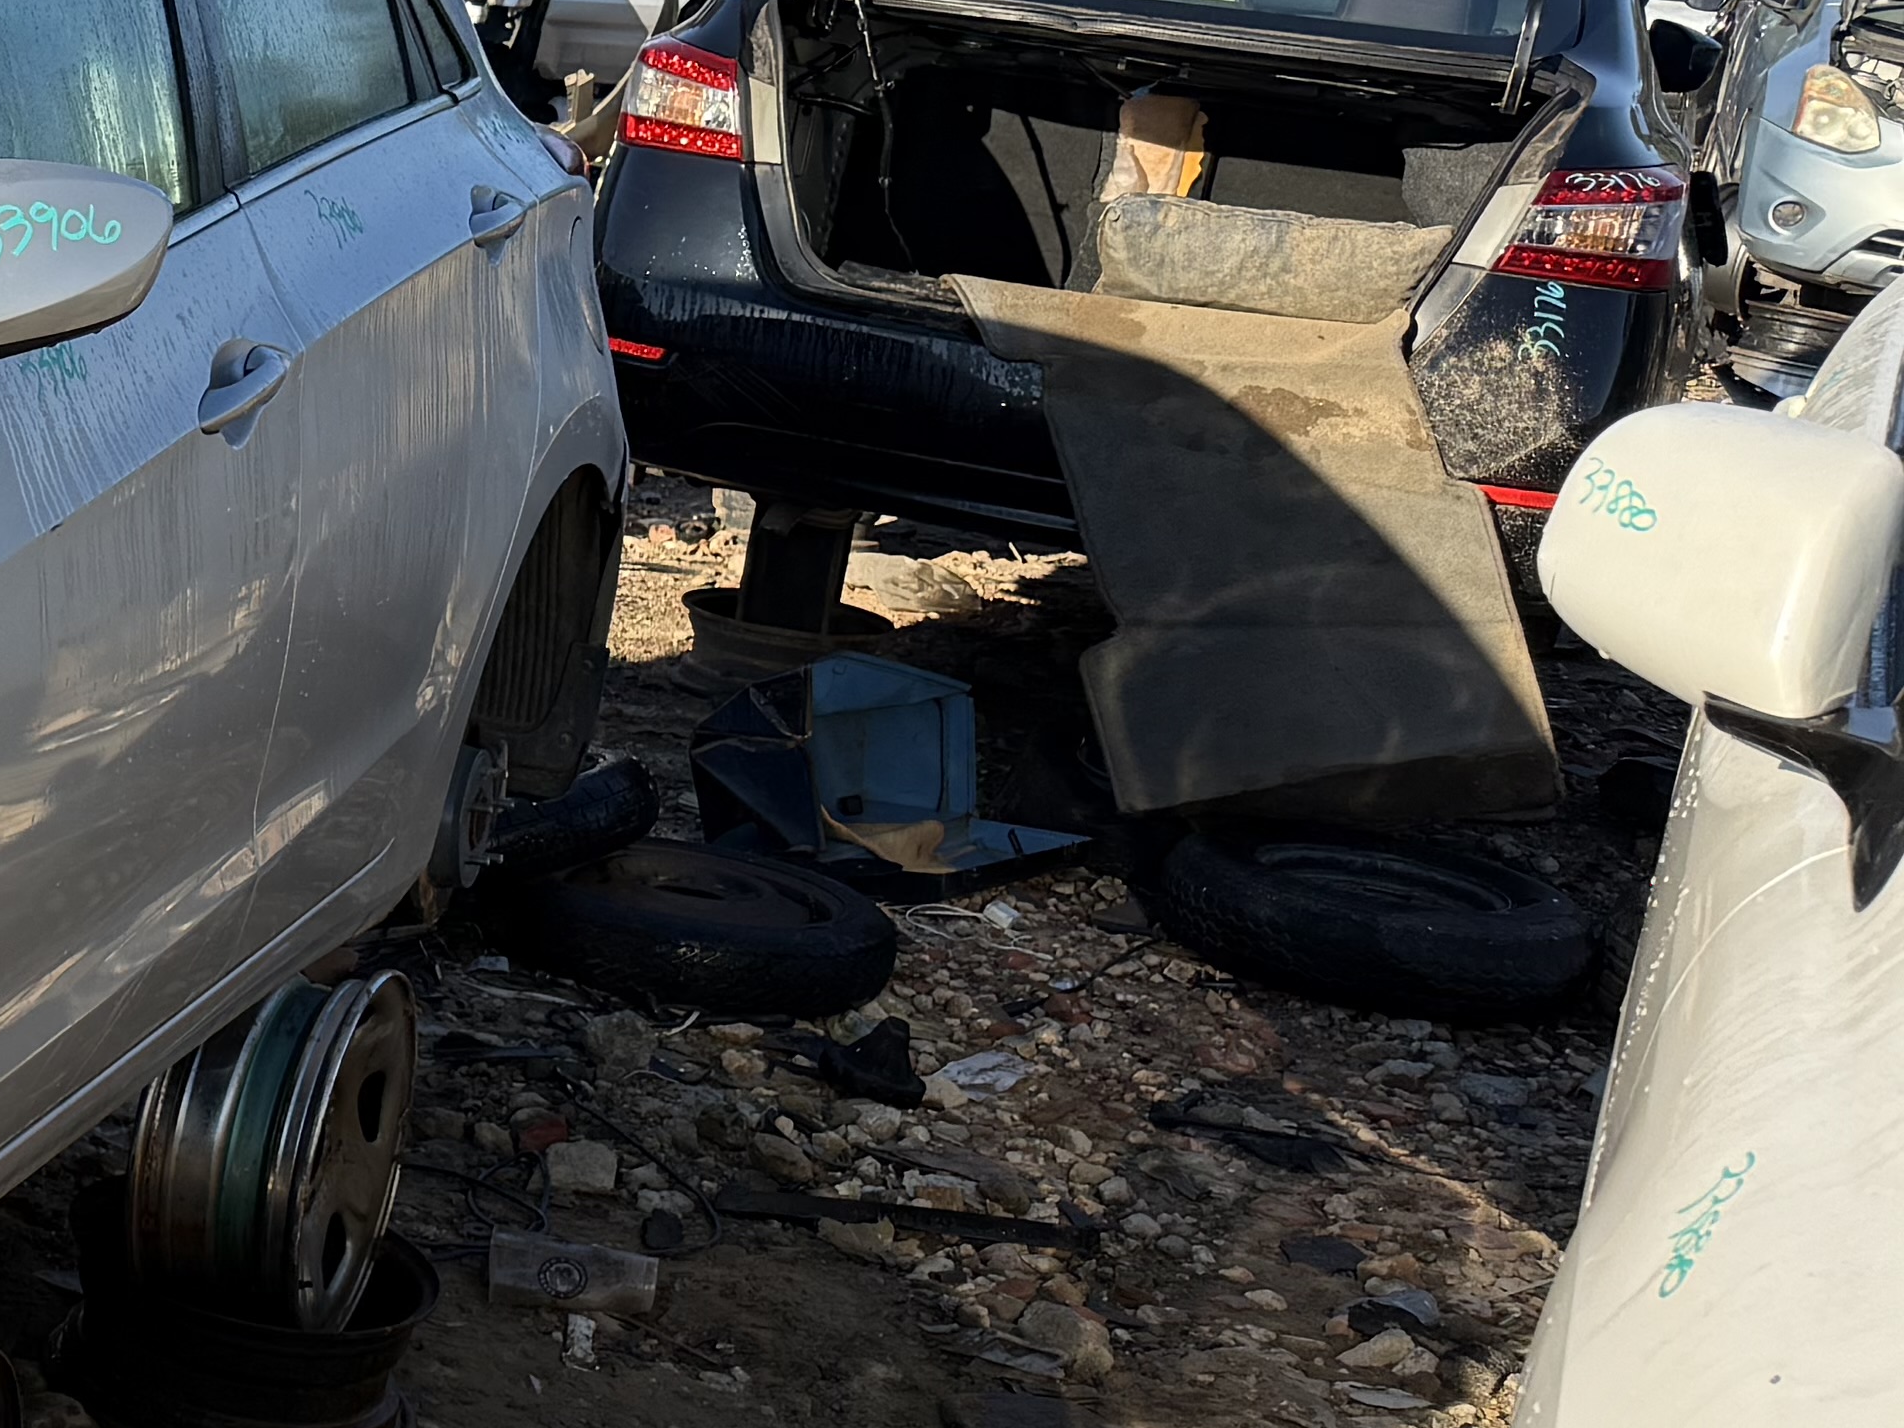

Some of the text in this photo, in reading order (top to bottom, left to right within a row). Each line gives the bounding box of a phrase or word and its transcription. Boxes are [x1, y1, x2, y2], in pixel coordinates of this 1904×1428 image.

[1565, 172, 1661, 193] 33176
[1518, 281, 1567, 361] 33176
[1579, 457, 1658, 531] 33880
